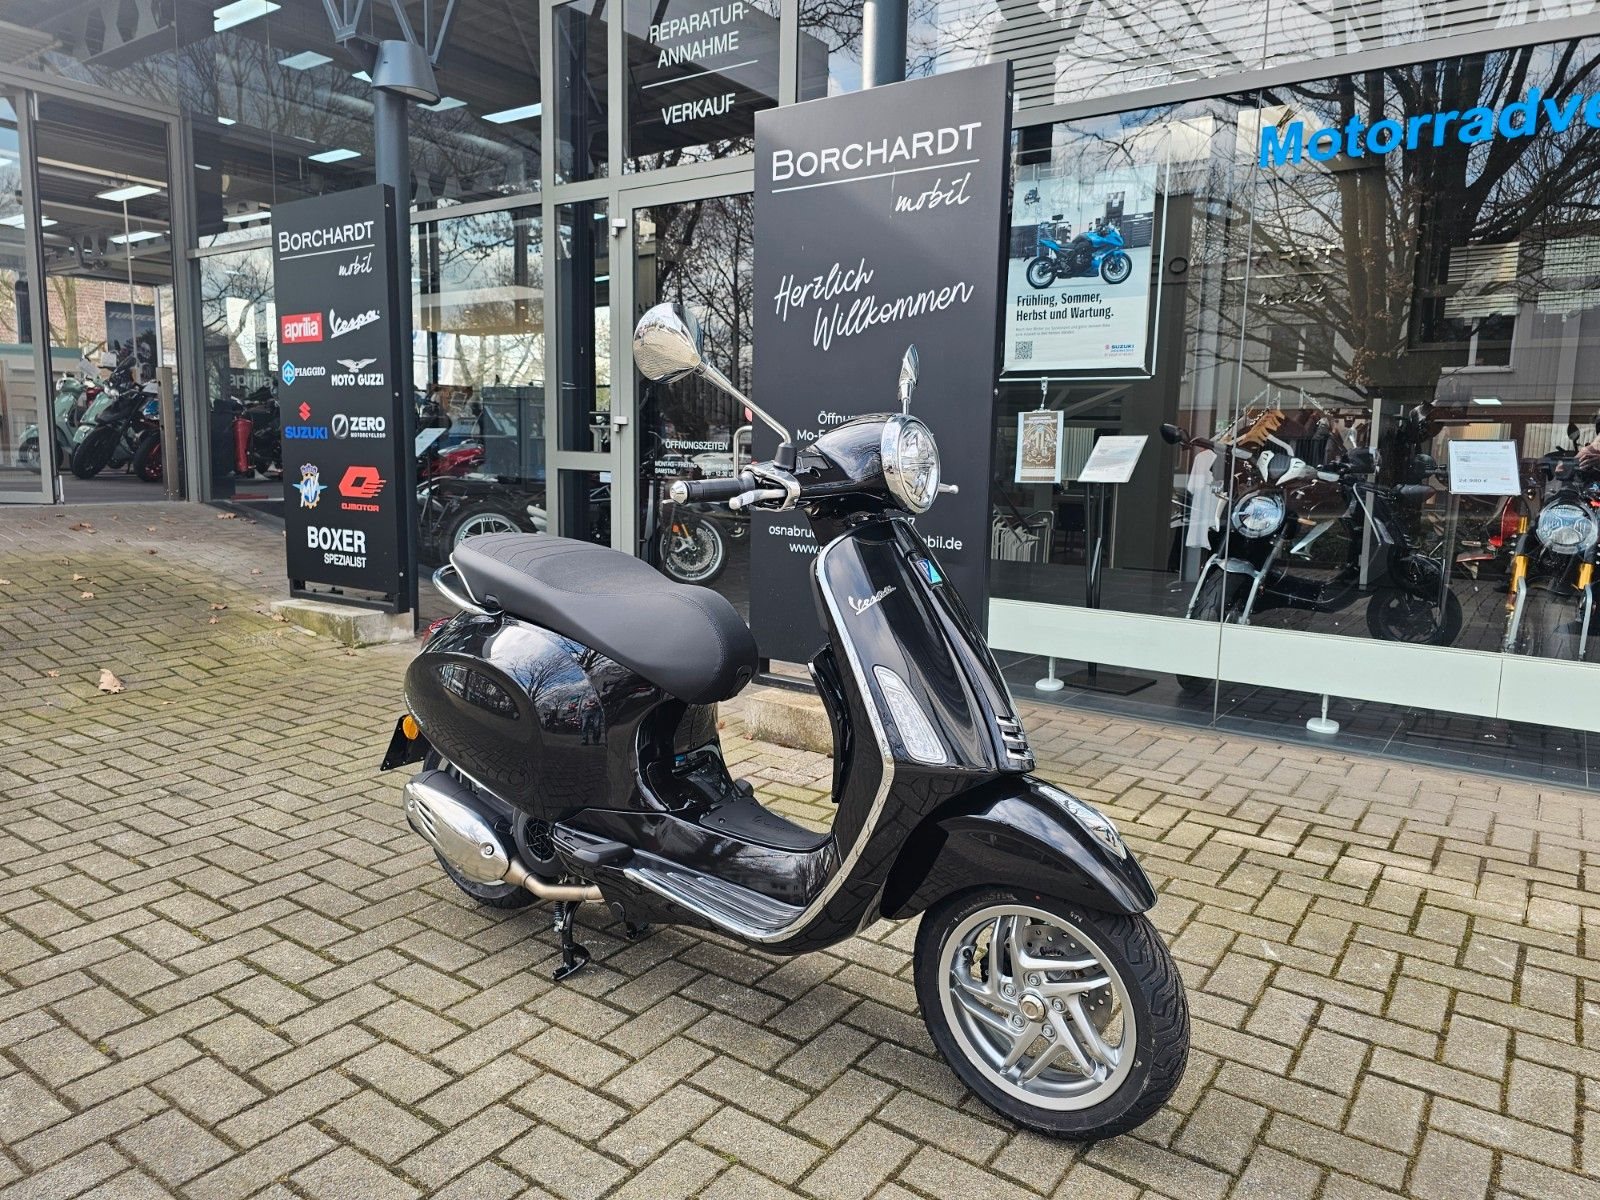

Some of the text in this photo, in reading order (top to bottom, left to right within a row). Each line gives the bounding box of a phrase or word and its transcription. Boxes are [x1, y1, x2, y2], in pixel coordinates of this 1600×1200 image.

[649, 5, 750, 44] REPARATUR-
[657, 31, 739, 69] ANNAHME
[661, 93, 736, 125] VERKAUF
[772, 122, 981, 182] BORCHARDT
[895, 172, 971, 213] mobil
[278, 221, 374, 252] BORCHARDT
[338, 252, 373, 277] mobil
[775, 258, 874, 322] Herzlich
[1016, 293, 1102, 308] Frühling, Sommer,
[329, 308, 380, 339] Vespa
[814, 281, 974, 351] Willkommen
[1016, 306, 1115, 321] Herbst und Wartung.
[284, 317, 319, 341] aprilia
[294, 366, 326, 377] PIAGGIO
[331, 373, 384, 386] MOTO GUZZI
[285, 426, 328, 439] SUZUKI
[350, 416, 386, 431] ZERO
[665, 439, 729, 450] ÖFFNUNGSZEITEN
[307, 526, 366, 553] BOXER
[324, 553, 367, 568] SPEZIALIST
[848, 585, 897, 616] Vespa
